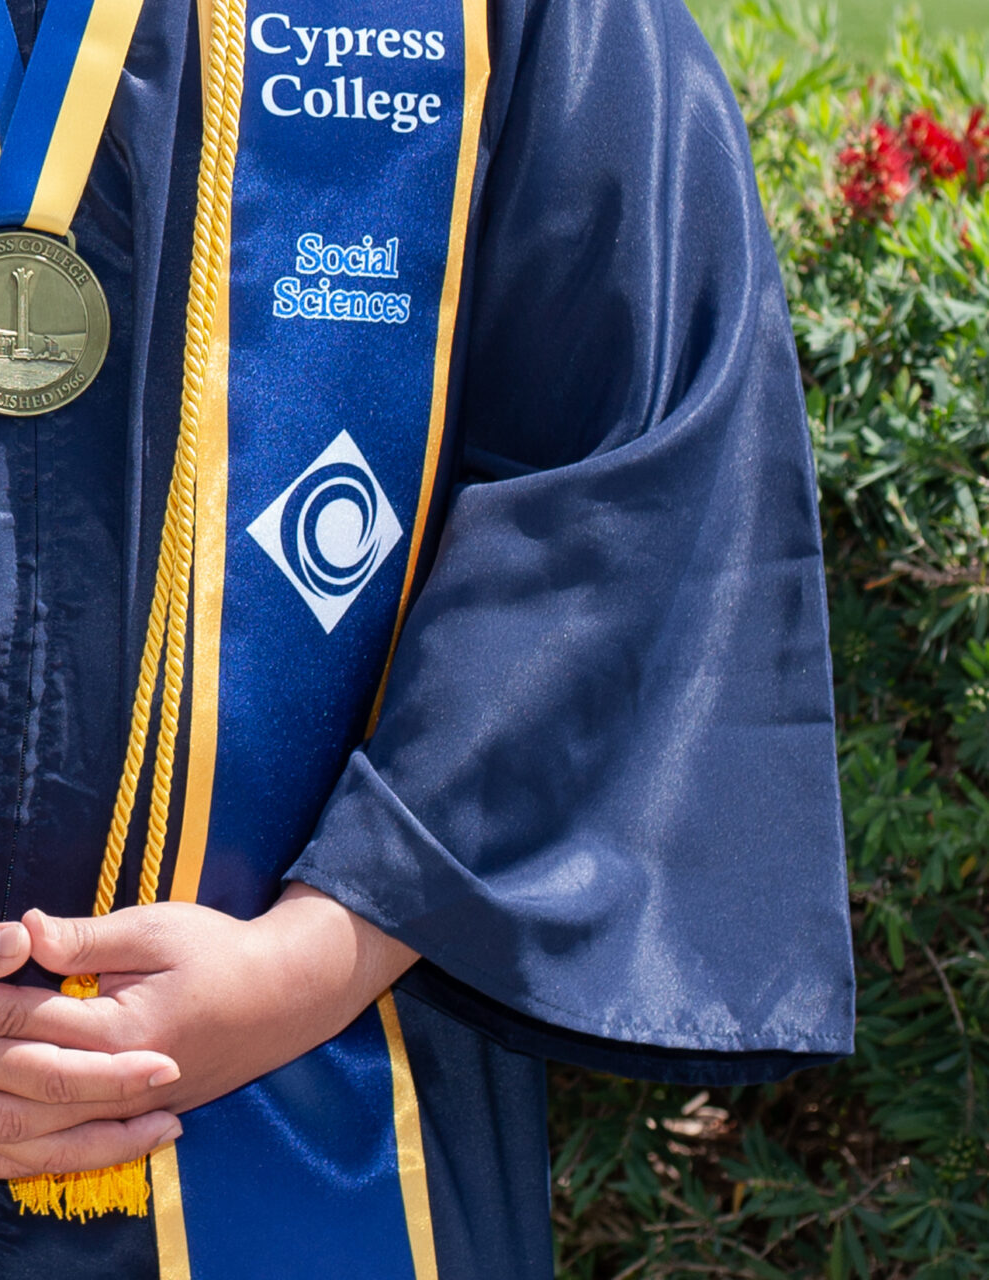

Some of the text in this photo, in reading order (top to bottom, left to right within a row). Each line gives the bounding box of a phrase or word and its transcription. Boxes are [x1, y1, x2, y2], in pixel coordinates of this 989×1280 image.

[250, 12, 446, 68] Cypress
[260, 73, 442, 134] College
[19, 238, 90, 287] COLLEGE
[296, 232, 400, 279] Social
[273, 276, 411, 324] Sciences
[56, 371, 86, 399] 1966
